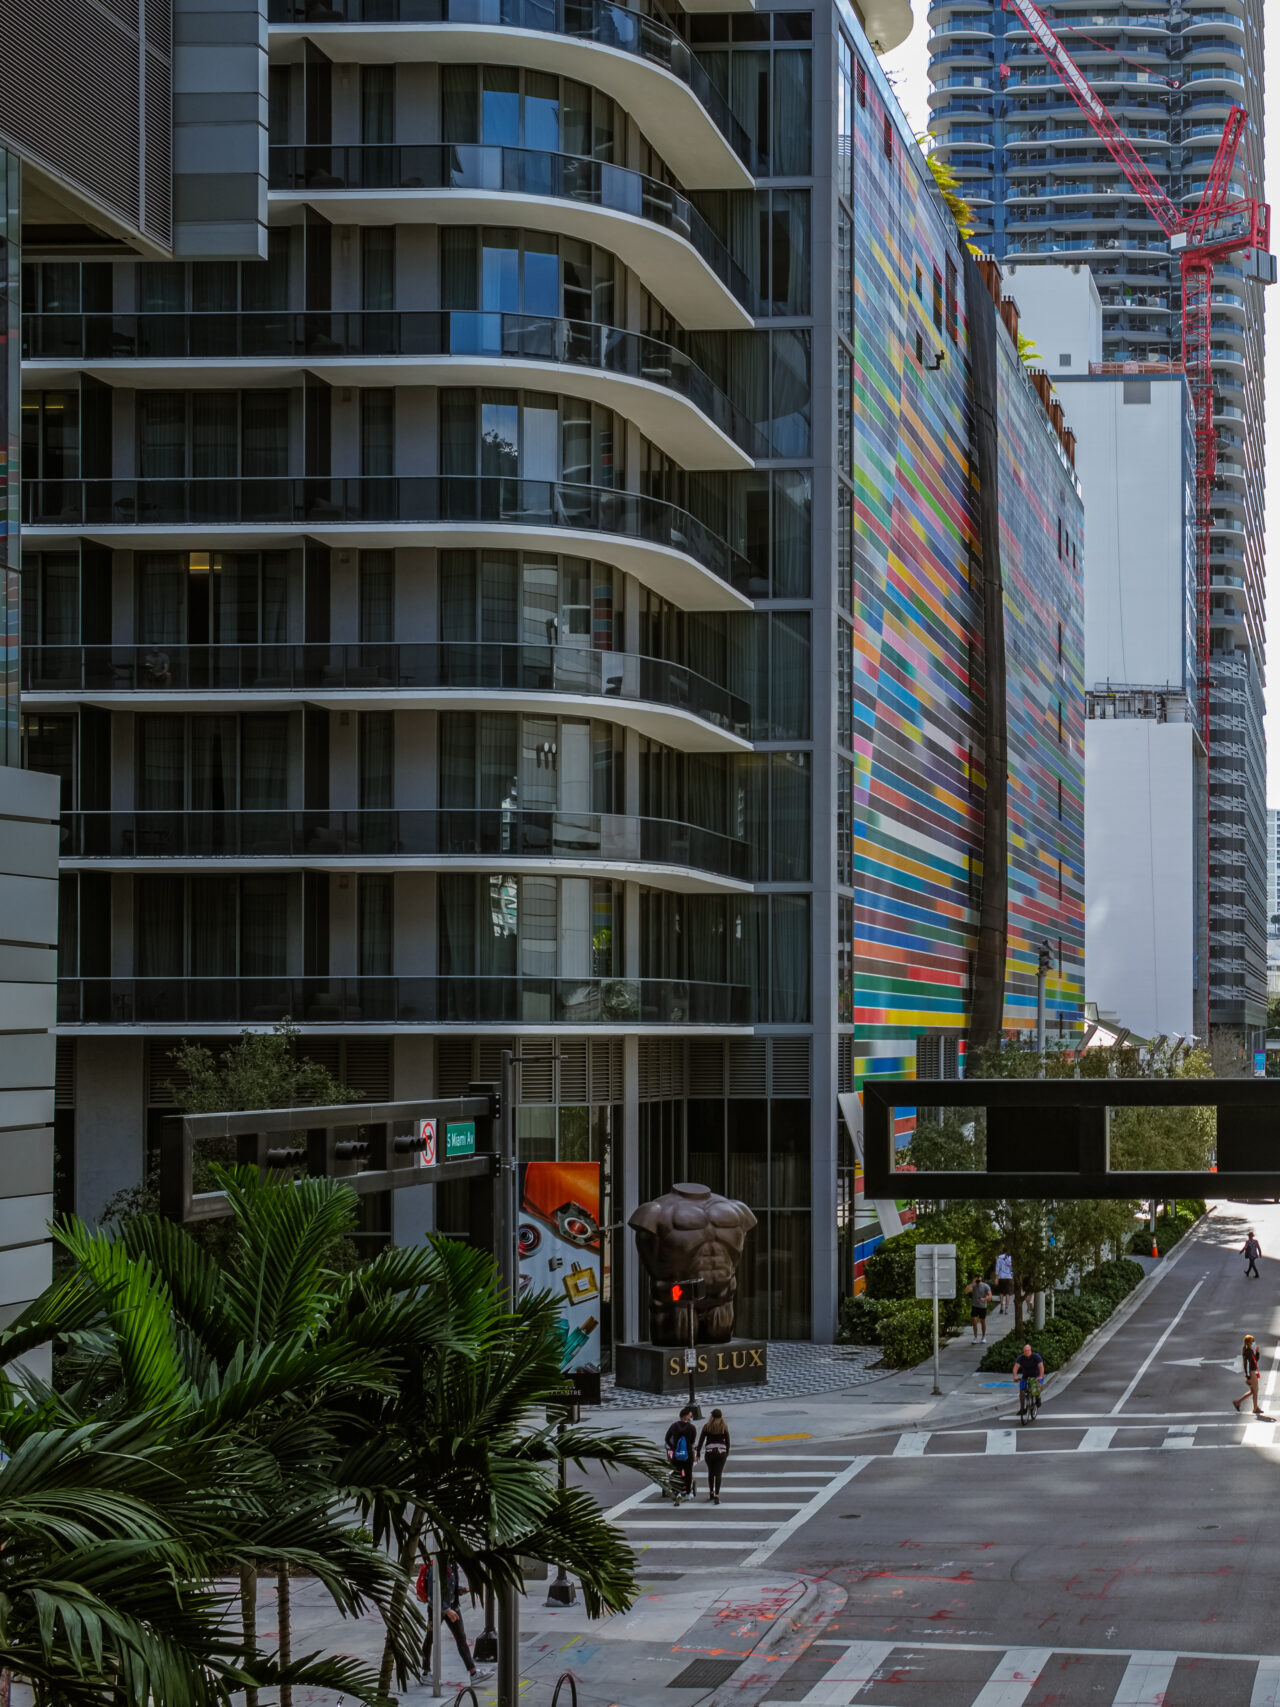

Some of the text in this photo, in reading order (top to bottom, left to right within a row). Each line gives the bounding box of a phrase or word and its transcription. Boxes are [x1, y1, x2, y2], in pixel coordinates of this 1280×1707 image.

[447, 1133, 451, 1147] S
[452, 1132, 466, 1147] Miami
[717, 1349, 764, 1371] LUX
